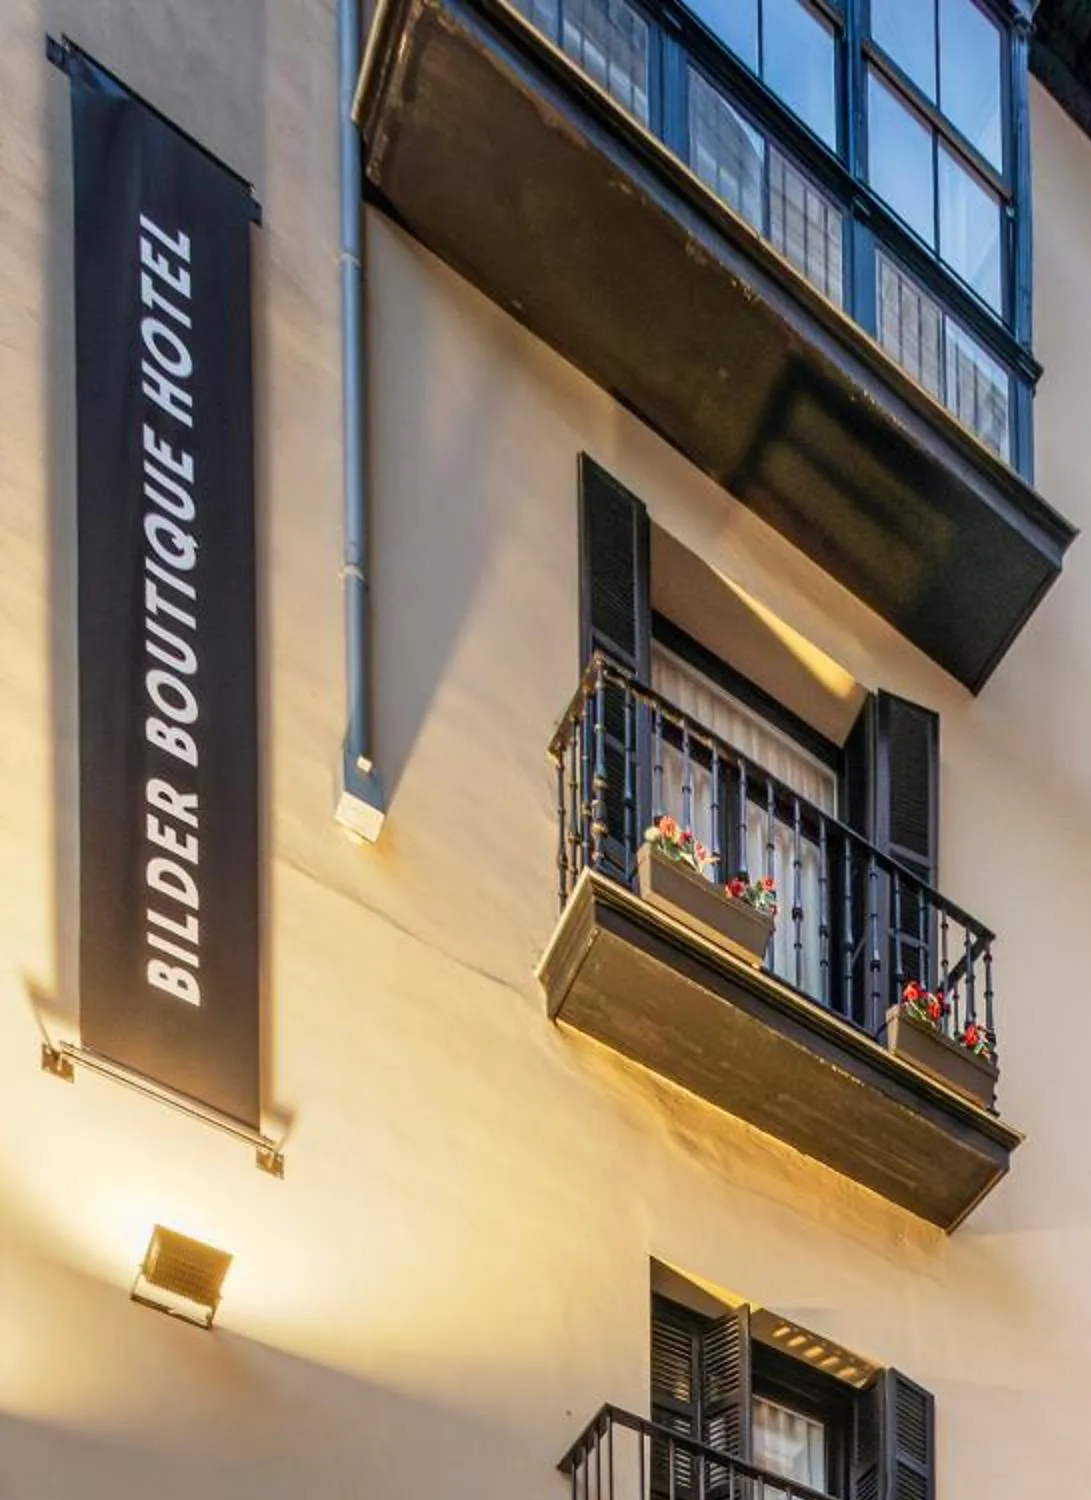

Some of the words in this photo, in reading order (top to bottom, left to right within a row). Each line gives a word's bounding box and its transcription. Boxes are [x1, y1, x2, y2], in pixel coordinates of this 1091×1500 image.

[138, 213, 193, 429] HOTEL
[142, 422, 199, 768] BOUTIQUE
[145, 777, 202, 1008] BILDER
